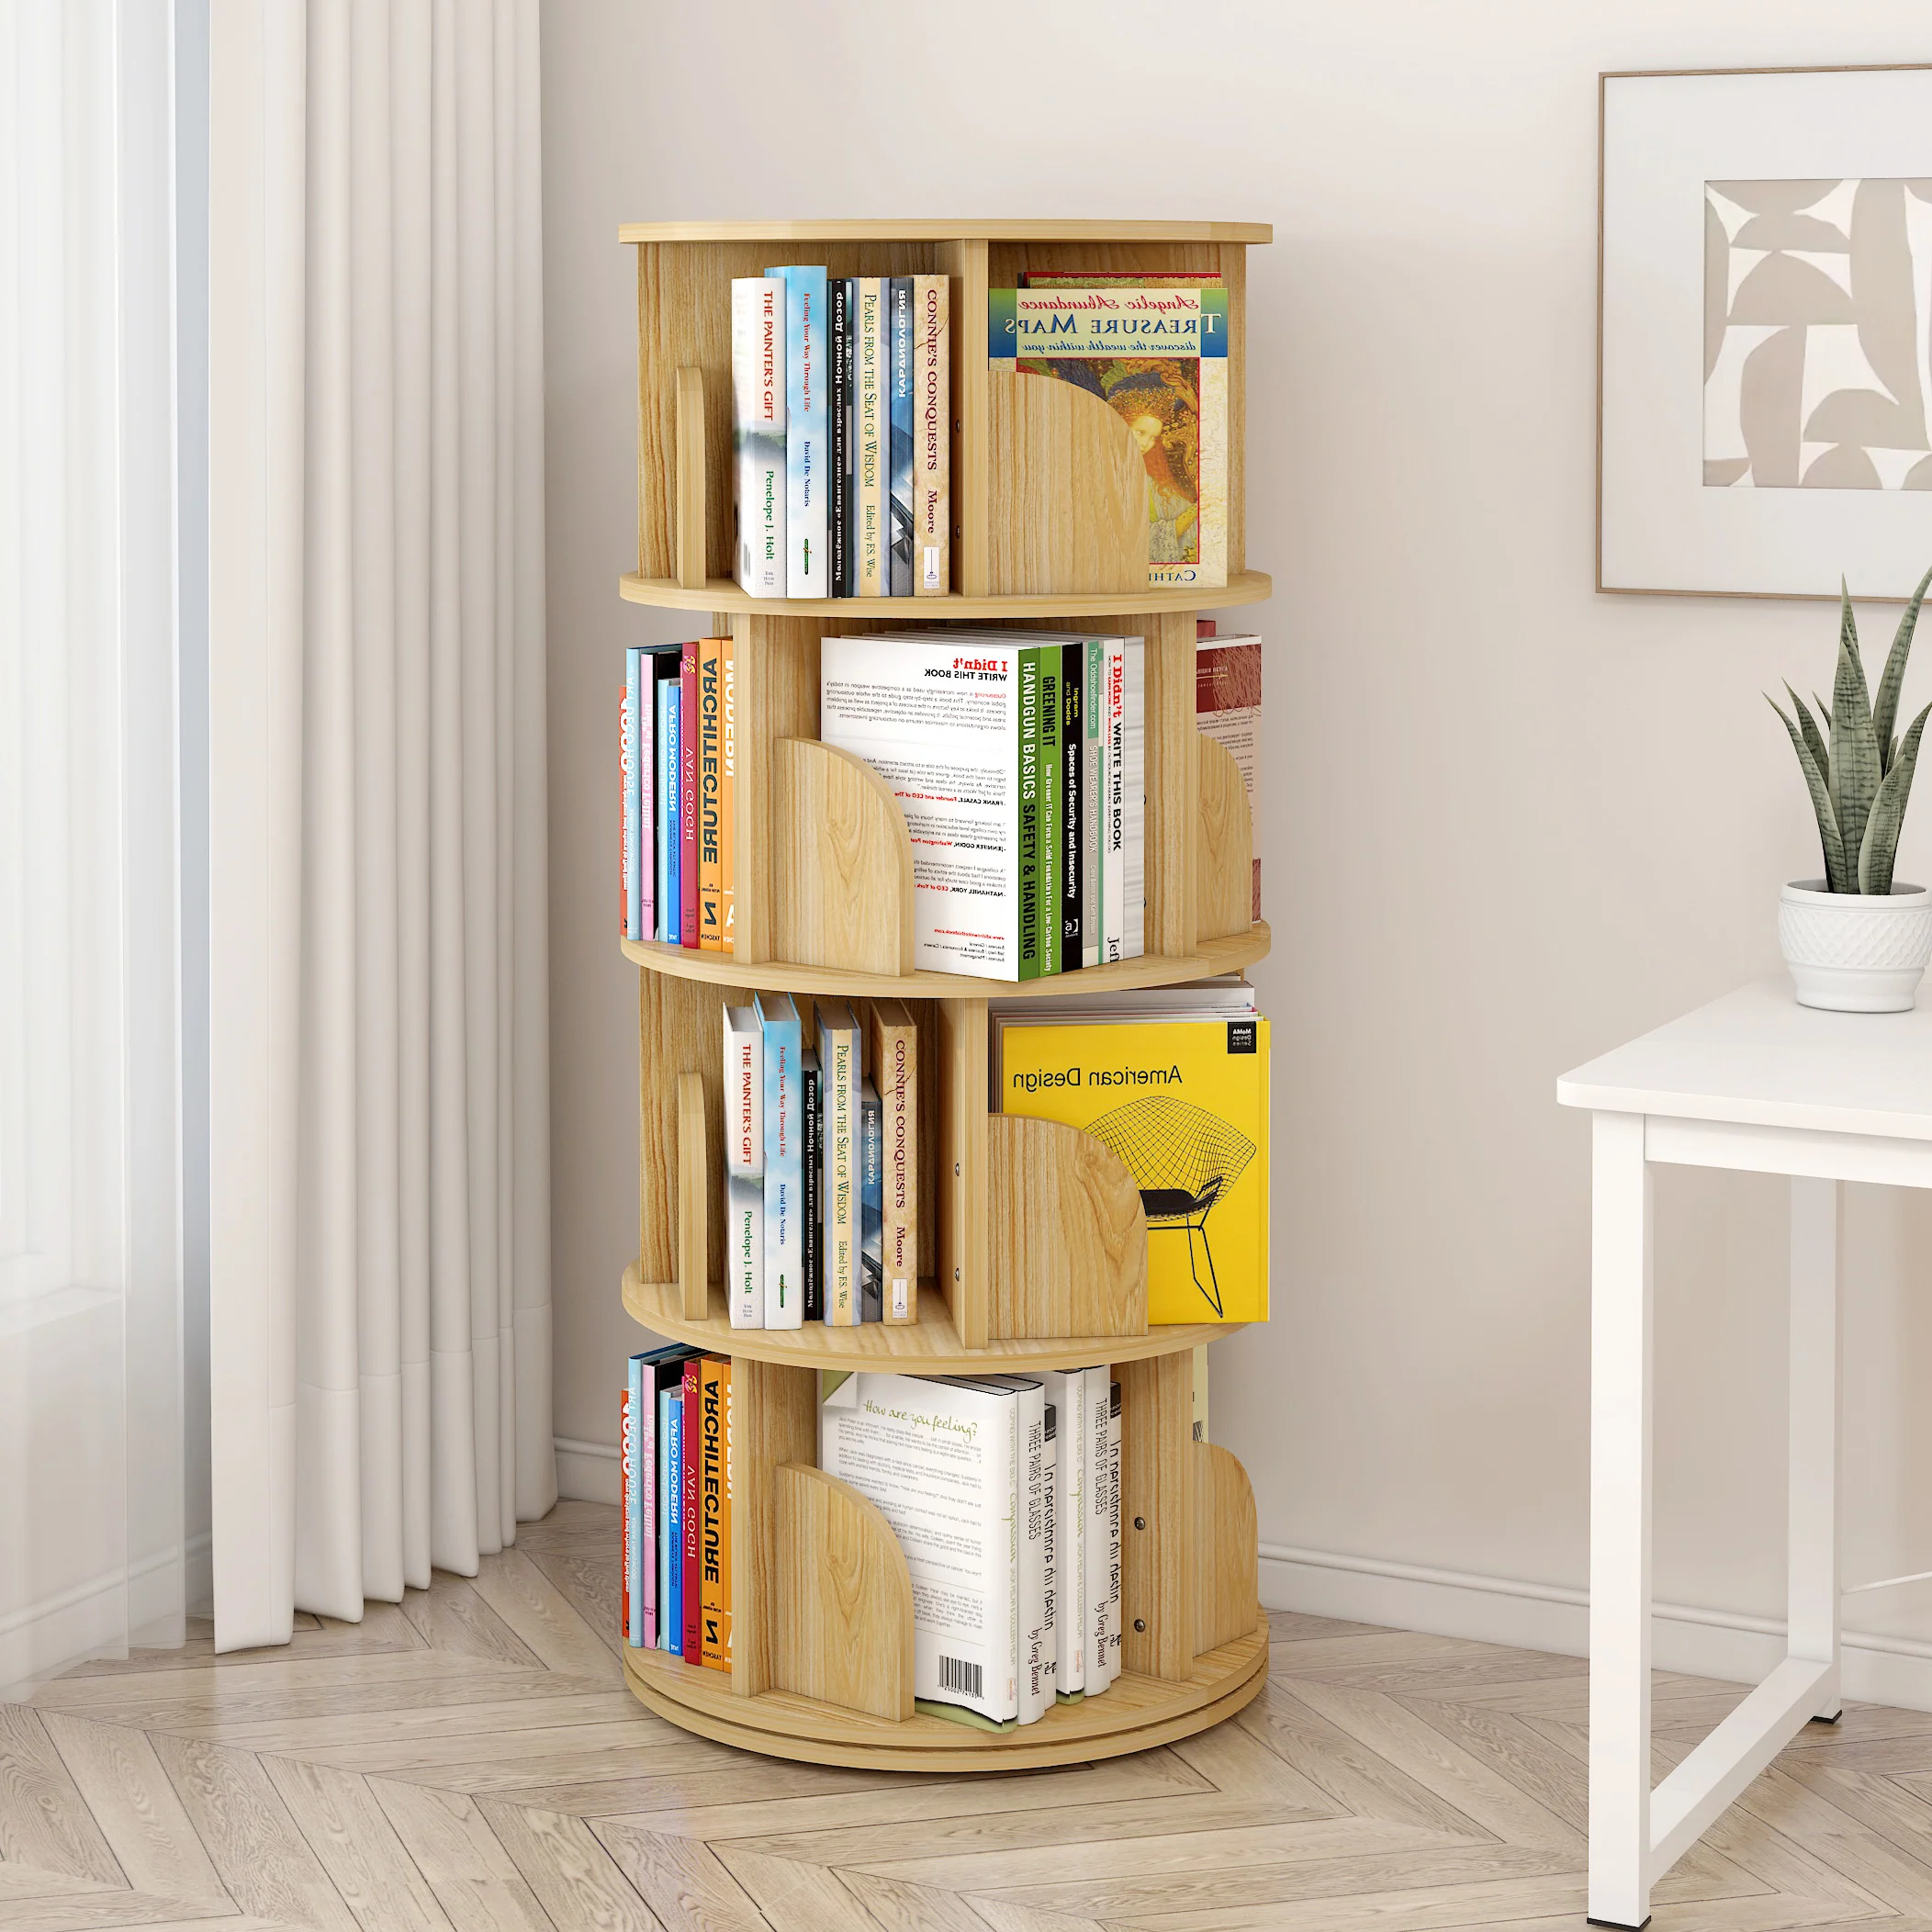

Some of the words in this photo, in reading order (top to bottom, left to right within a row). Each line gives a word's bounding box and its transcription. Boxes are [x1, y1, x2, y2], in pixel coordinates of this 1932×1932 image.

[764, 291, 773, 317] THE
[835, 292, 843, 331] Дозор
[865, 294, 877, 333] PEARLS
[927, 289, 938, 366] CONNIE'S
[764, 321, 773, 387] PAINTER'S
[803, 345, 811, 359] Way
[835, 335, 843, 384] Ночной
[865, 337, 875, 365] FROM
[865, 368, 875, 390] THE
[764, 390, 773, 421] GIFT
[865, 393, 877, 420] SEAT
[926, 372, 938, 470] CONQUESTS
[865, 423, 875, 438] OF
[804, 466, 811, 476] De
[865, 441, 877, 488] WISDOM
[764, 470, 774, 521] Penelope
[866, 505, 875, 530] Edited
[927, 490, 938, 534] Moore
[766, 537, 775, 560] Holt
[865, 533, 875, 541] by
[866, 559, 875, 578] Wise
[1113, 655, 1122, 663] I
[1022, 661, 1036, 739] HANDGUN
[1042, 676, 1056, 734] GREENING
[1113, 666, 1122, 718] Didn't
[1042, 736, 1056, 747] IT
[1089, 745, 1097, 767] SHOE
[1113, 722, 1122, 768] WRITE
[1022, 743, 1036, 800] BASICS
[1067, 743, 1076, 778] Spaces
[1068, 779, 1076, 789] of
[1089, 769, 1097, 807] WEARER'S
[1113, 771, 1122, 804] THIS
[1067, 790, 1076, 830] Security
[1023, 803, 1036, 859] SAFETY
[1068, 831, 1076, 849] and
[1089, 809, 1097, 853] HANDBOOK
[1113, 808, 1122, 851] BOOK
[1023, 864, 1036, 877] &
[1067, 850, 1076, 899] Insecurity
[1022, 880, 1036, 960] HANDLING
[742, 1043, 752, 1069] THE
[837, 1044, 848, 1081] PEARLS
[895, 1039, 906, 1111] CONNIE'S
[742, 1073, 752, 1133] PAINTER'S
[837, 1084, 847, 1111] FROM
[837, 1114, 847, 1134] THE
[742, 1137, 752, 1164] GIFT
[837, 1137, 848, 1163] SEAT
[894, 1116, 905, 1208] CONQUESTS
[837, 1165, 847, 1178] OF
[781, 1208, 786, 1216] De
[837, 1181, 848, 1225] WISDOM
[744, 1211, 753, 1258] Penelope
[896, 1227, 905, 1267] Moore
[838, 1241, 848, 1264] Edited
[745, 1273, 753, 1294] Holt
[837, 1266, 848, 1275] by
[838, 1290, 848, 1309] Wise
[863, 1398, 886, 1416] How
[889, 1410, 908, 1421] are
[911, 1415, 931, 1430] you
[932, 1416, 978, 1443] feeling?
[1095, 1398, 1107, 1430] THREE
[1028, 1421, 1041, 1453] THREE
[1095, 1430, 1107, 1458] PAIRS
[1028, 1453, 1041, 1482] PAIRS
[1095, 1458, 1107, 1471] OF
[1028, 1482, 1041, 1496] OF
[1095, 1473, 1107, 1515] GLASSES
[1028, 1497, 1041, 1540] GLASSES
[1094, 1601, 1107, 1613] by
[1028, 1627, 1042, 1640] by
[1094, 1614, 1107, 1636] Greg
[1028, 1641, 1042, 1663] Greg
[1096, 1637, 1107, 1668] Bennet
[1030, 1664, 1042, 1696] Bennet
